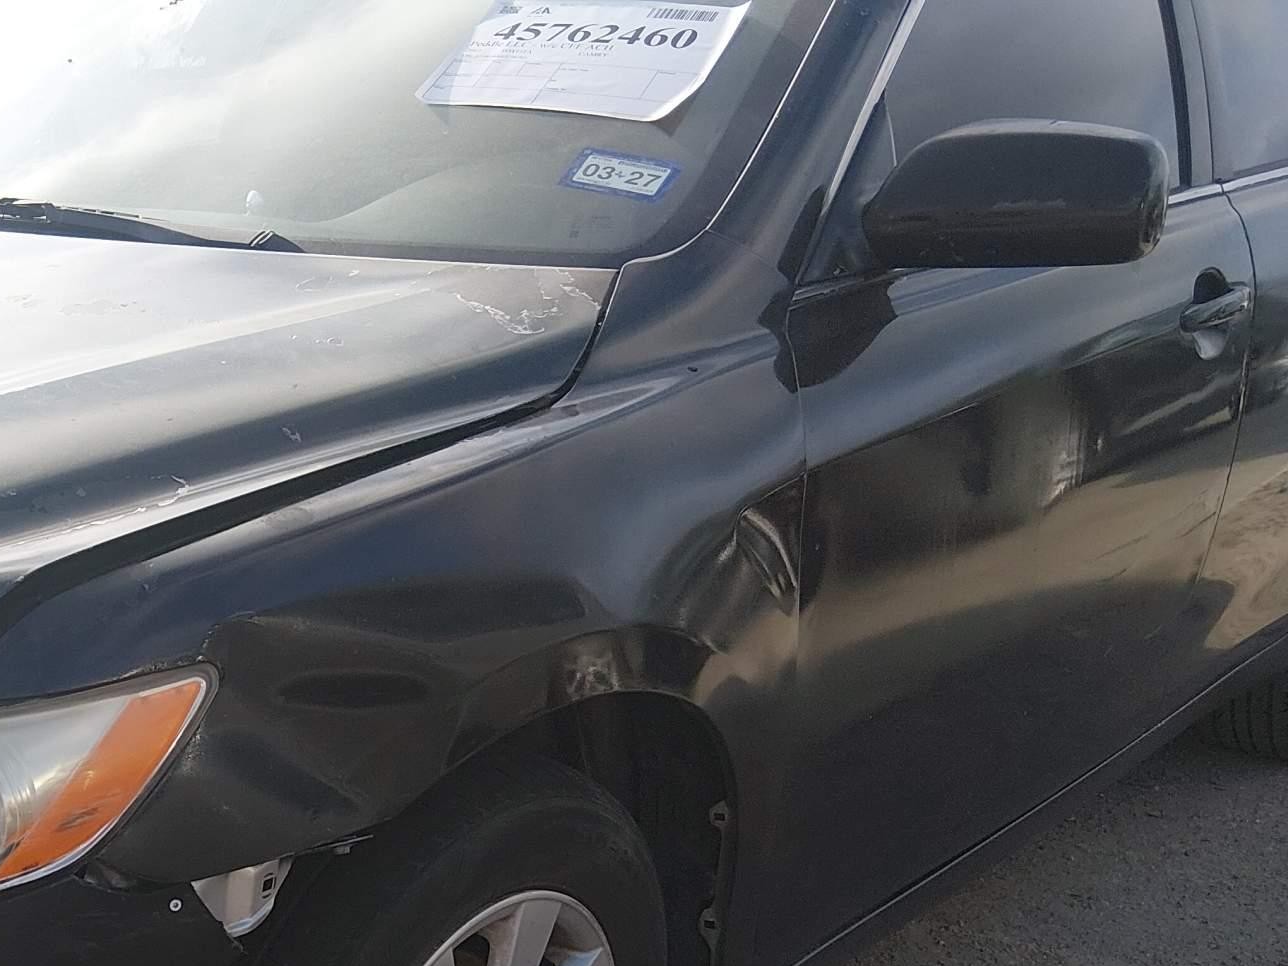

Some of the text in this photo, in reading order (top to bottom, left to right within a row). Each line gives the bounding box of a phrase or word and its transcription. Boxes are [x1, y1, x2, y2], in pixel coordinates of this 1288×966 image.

[493, 22, 698, 49] 45762460
[582, 163, 616, 180] 03
[624, 171, 662, 187] 27
